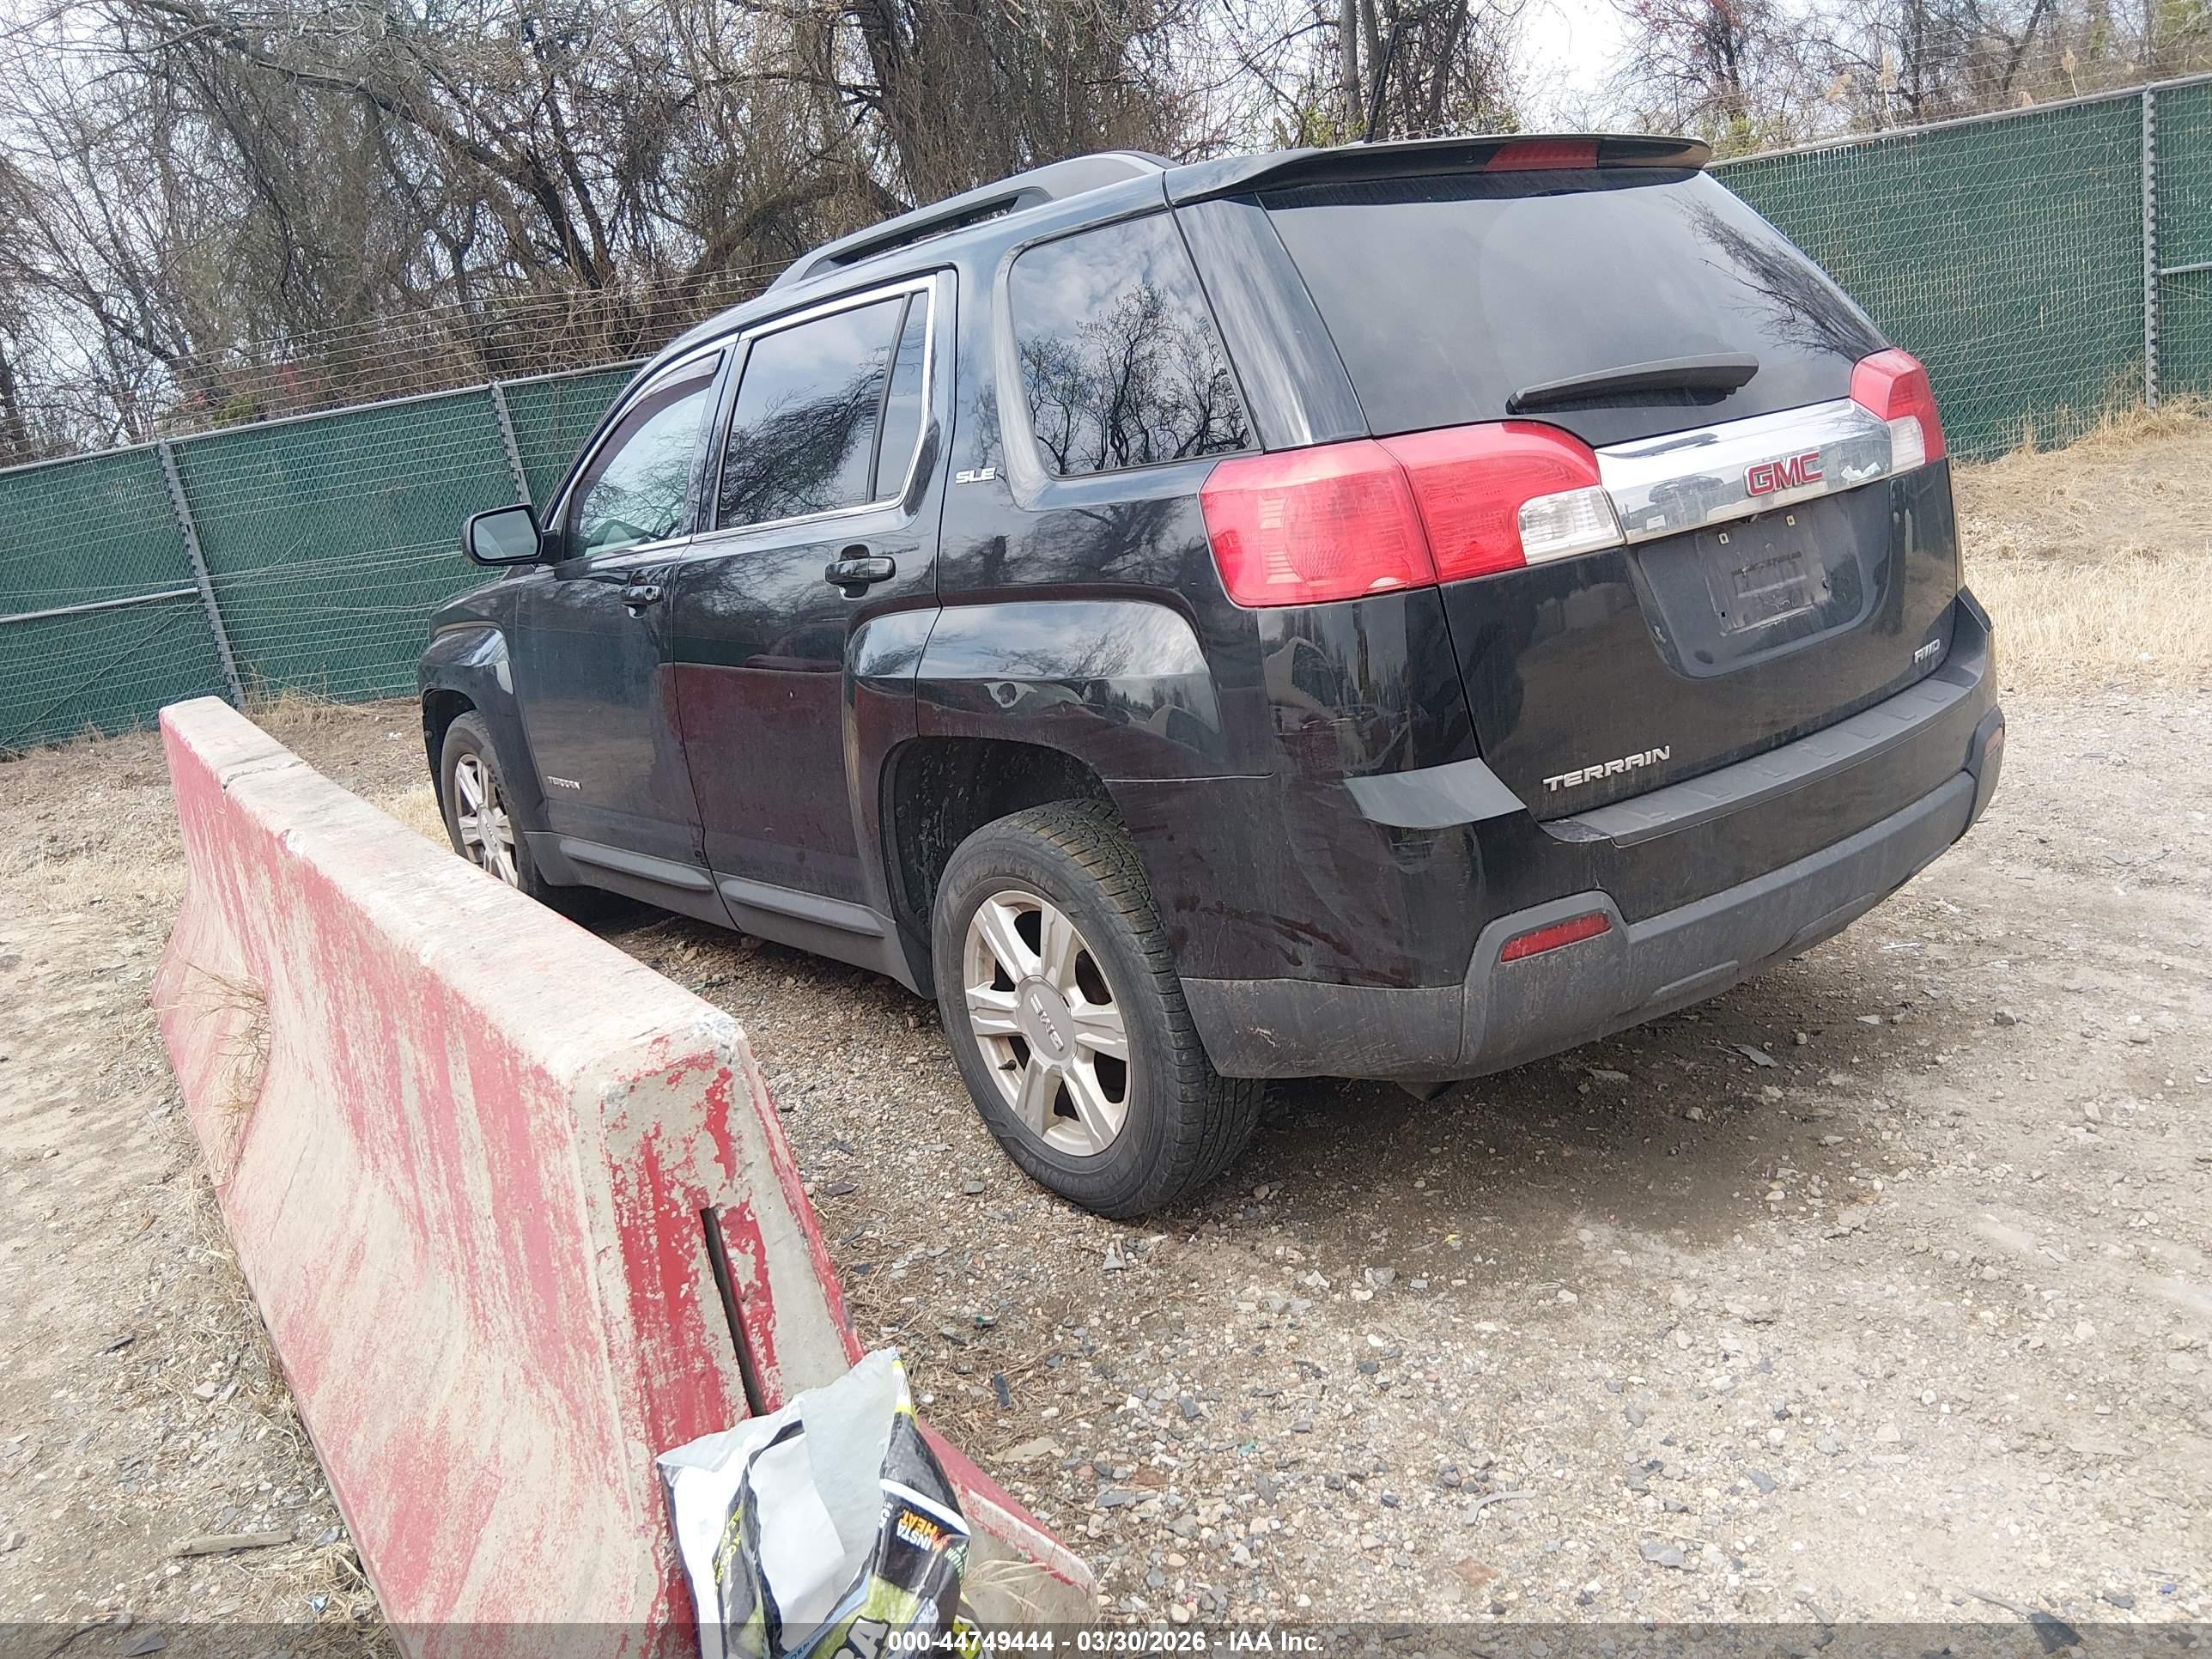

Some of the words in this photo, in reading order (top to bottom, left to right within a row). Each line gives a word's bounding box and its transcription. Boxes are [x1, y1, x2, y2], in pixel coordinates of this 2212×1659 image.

[955, 466, 997, 484] SLE
[1744, 450, 1823, 496] GMC
[1542, 744, 1670, 792] TERRAIN
[1030, 993, 1064, 1052] GMC
[896, 1518, 933, 1552] INSTA
